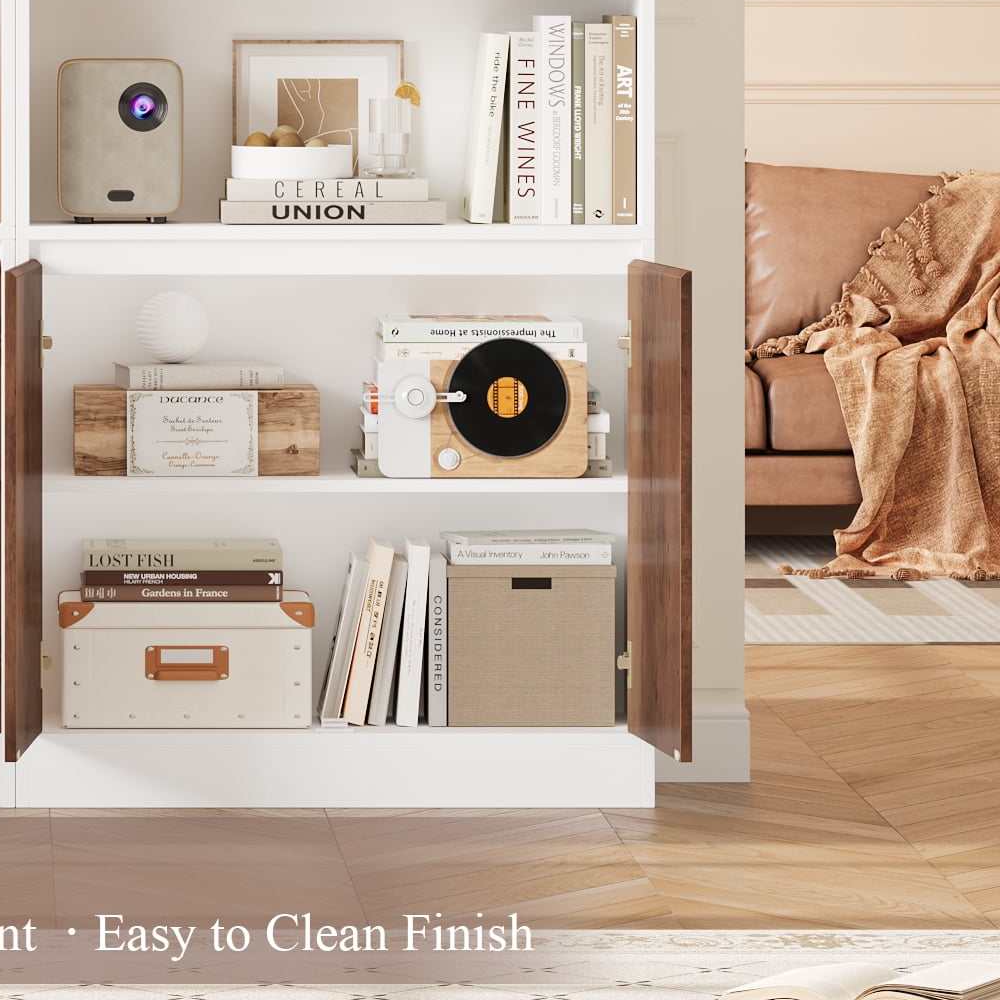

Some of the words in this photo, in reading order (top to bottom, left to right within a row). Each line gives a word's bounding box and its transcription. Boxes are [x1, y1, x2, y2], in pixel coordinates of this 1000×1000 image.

[492, 52, 501, 73] ride
[548, 22, 566, 108] WINDOWS
[490, 75, 499, 93] the
[517, 59, 536, 110] FINE
[616, 64, 633, 99] ART
[574, 85, 582, 108] FRANK
[488, 95, 497, 118] bike
[574, 109, 582, 132] LLOYD
[574, 132, 582, 160] WRIGHT
[517, 121, 536, 198] WINES
[274, 180, 384, 198] CEREAL
[271, 204, 365, 220] UNION
[430, 328, 456, 337] Home
[459, 328, 468, 337] at
[471, 327, 537, 338] Impressionists
[540, 328, 557, 338] The
[89, 553, 132, 568] LOST
[137, 553, 175, 568] FISH
[457, 550, 464, 558] A
[465, 550, 487, 558] Visual
[488, 550, 523, 559] Inventory
[539, 551, 558, 559] John
[559, 551, 590, 559] Pawson
[141, 588, 182, 598] Gardens
[183, 588, 193, 598] in
[195, 588, 229, 598] France
[433, 595, 443, 692] CONSIDERED
